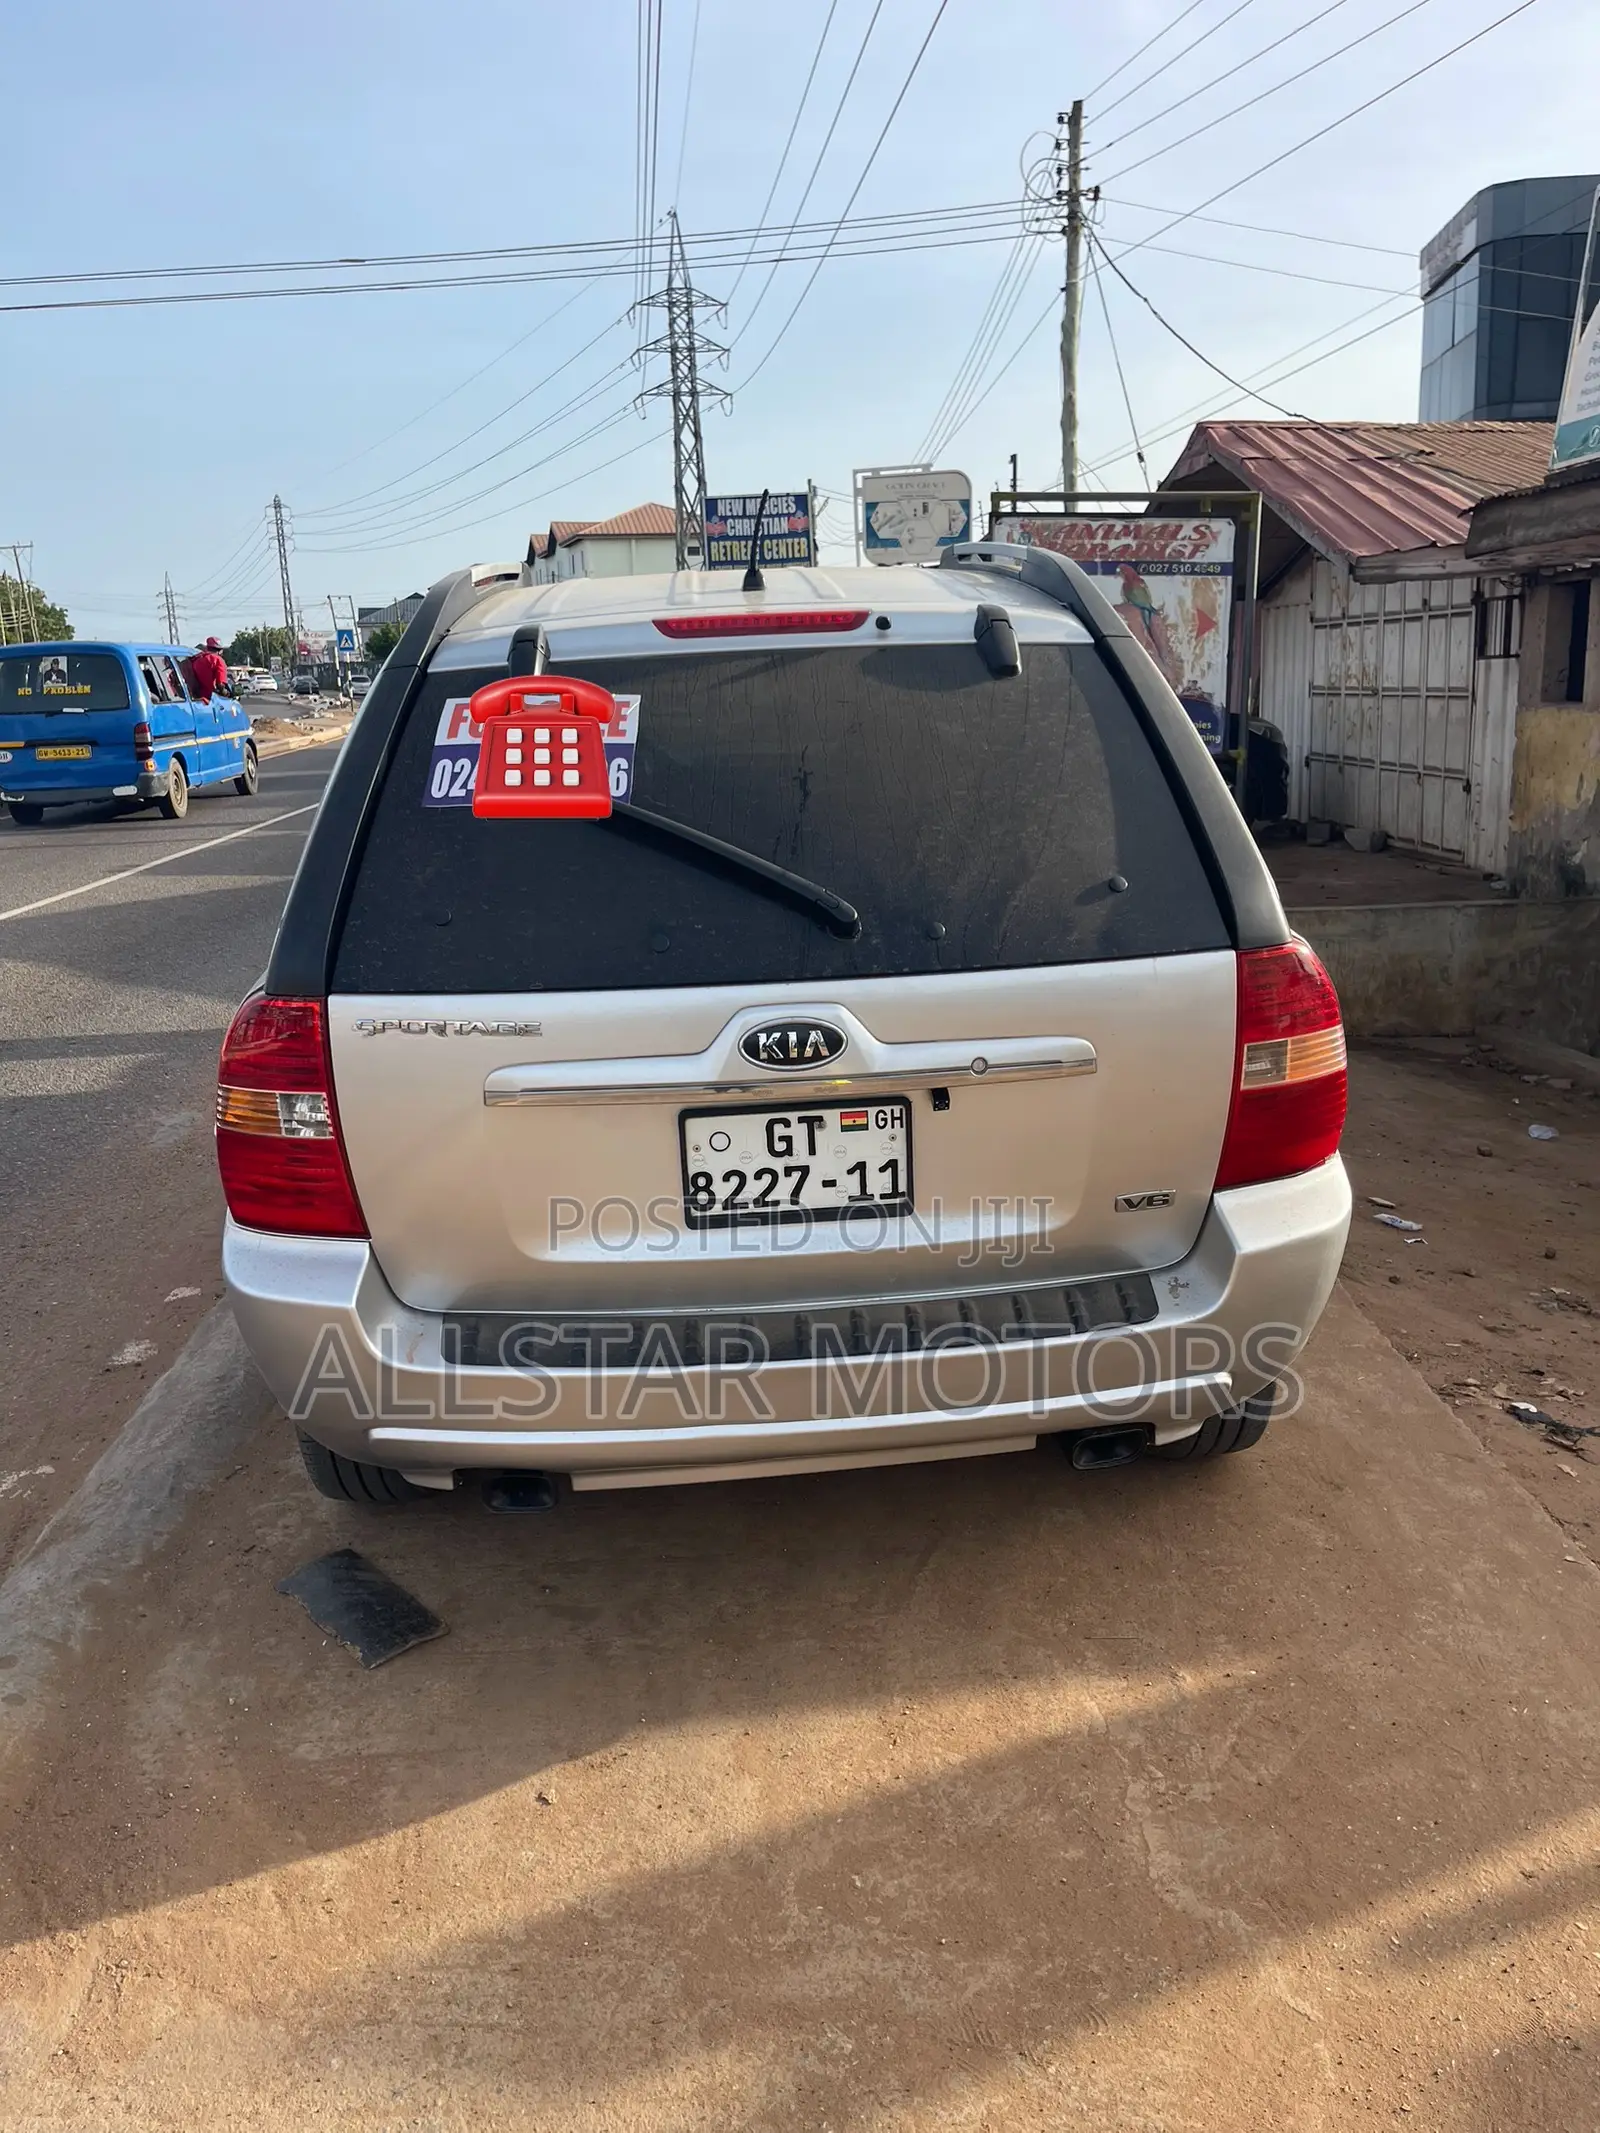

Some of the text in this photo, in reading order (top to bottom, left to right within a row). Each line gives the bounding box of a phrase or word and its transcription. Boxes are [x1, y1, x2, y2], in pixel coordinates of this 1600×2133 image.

[717, 496, 797, 517] NEW MERCIES
[1051, 522, 1211, 541] ANIMALS
[710, 537, 809, 562] RETRE CENTER
[1149, 564, 1169, 574] 027
[1172, 564, 1192, 573] 510
[17, 687, 32, 696] NO
[352, 1019, 543, 1037] SPORTAGE
[756, 1029, 830, 1060] KIA
[765, 1108, 905, 1158] GT GH
[1122, 1193, 1170, 1210] V6
